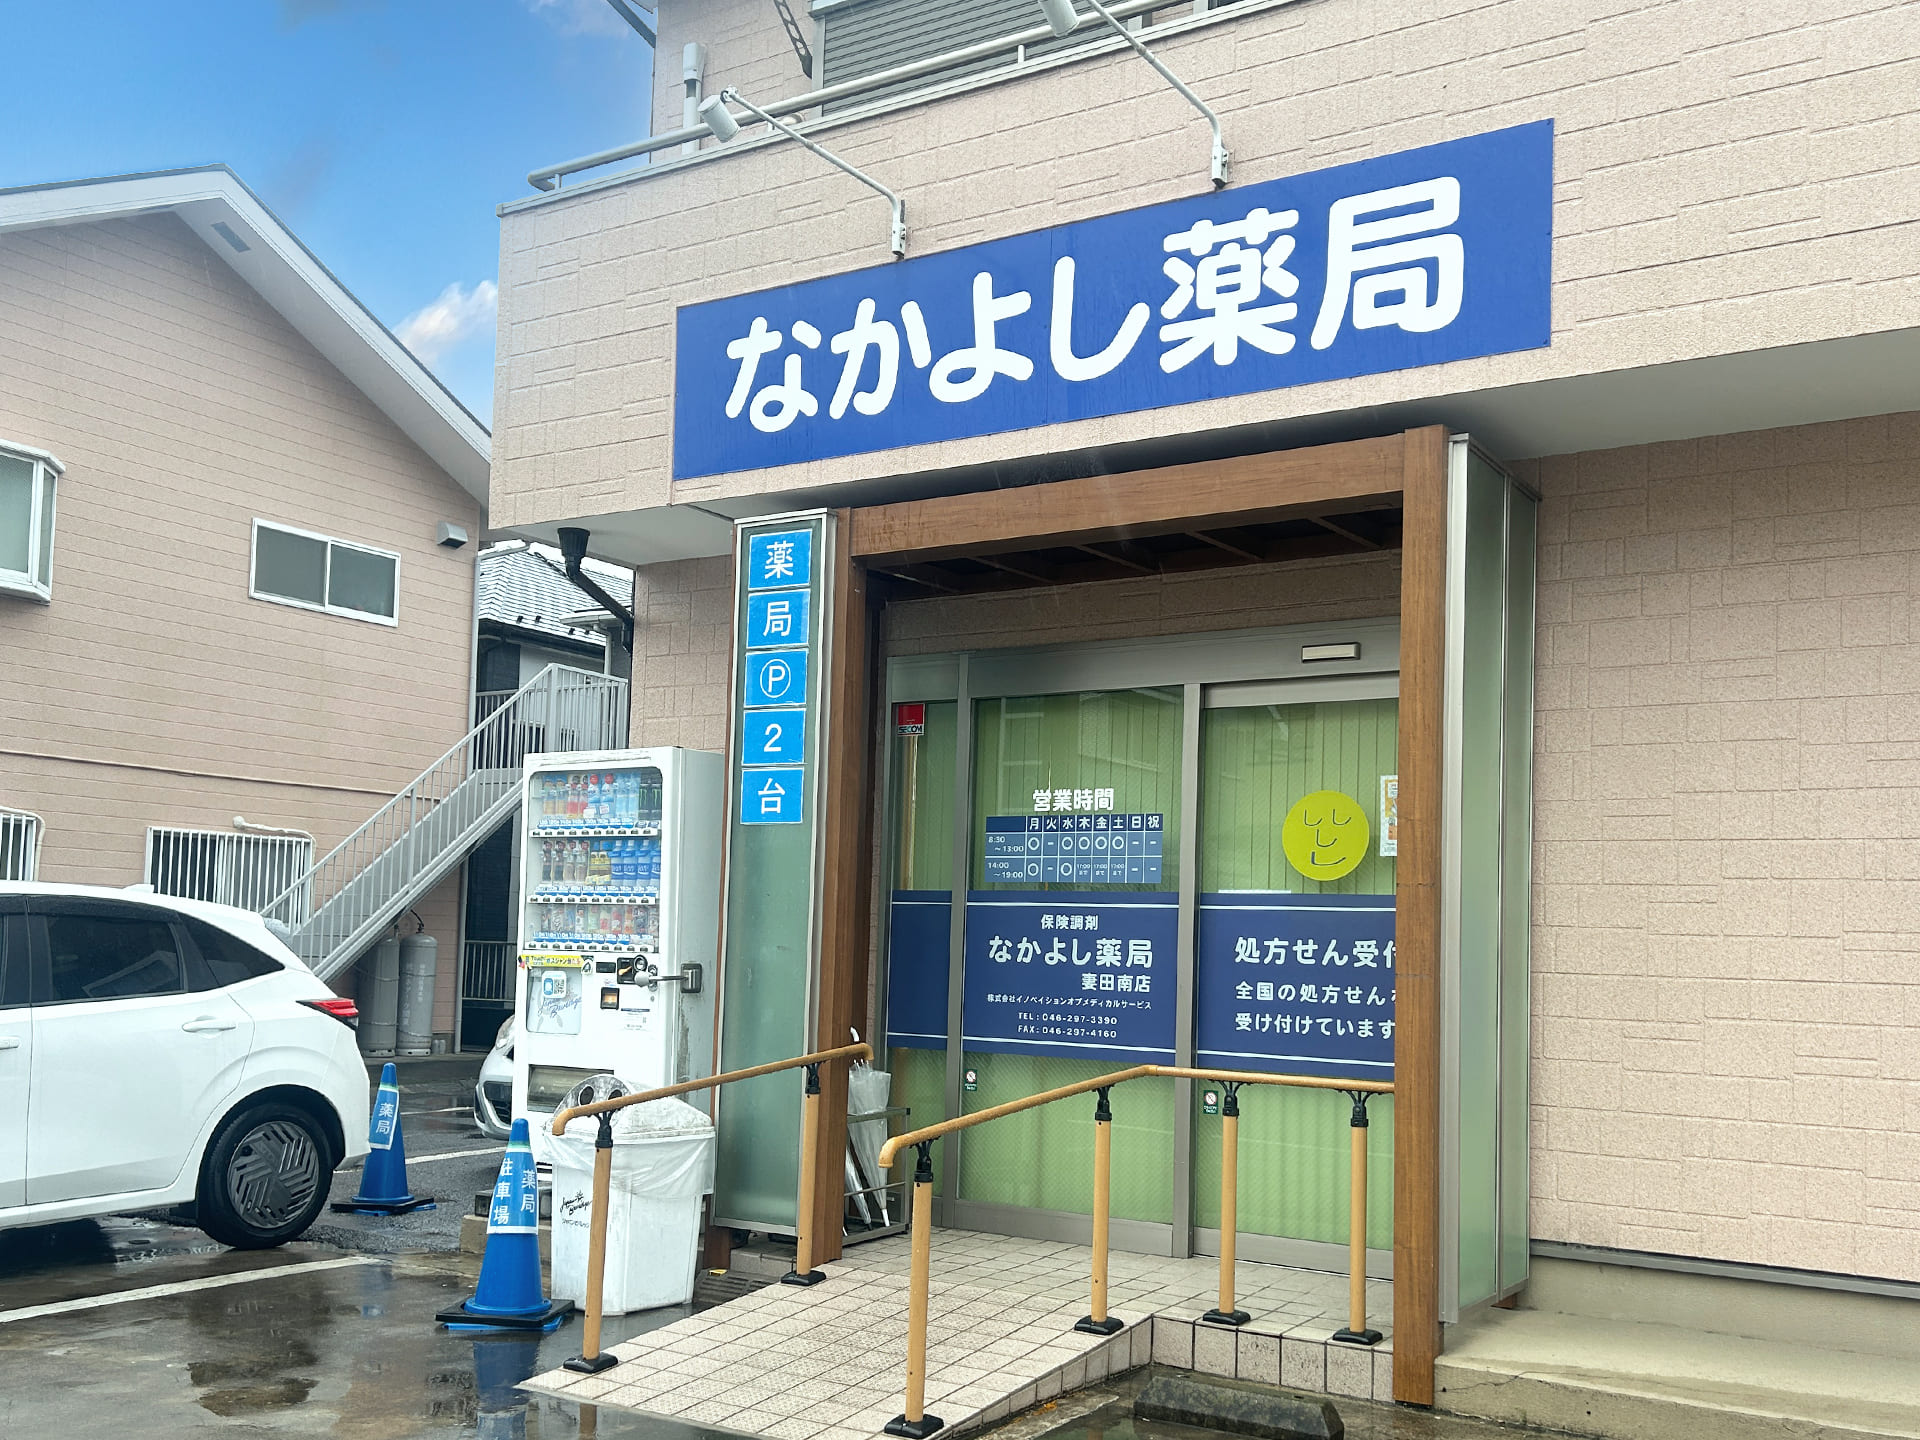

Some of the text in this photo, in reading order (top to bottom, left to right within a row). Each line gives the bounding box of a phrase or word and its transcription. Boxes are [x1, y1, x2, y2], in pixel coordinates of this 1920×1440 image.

[726, 177, 1465, 434] なかよし薬局
[1032, 788, 1115, 812] 営業時間
[1029, 815, 1160, 830] 月 火 水 木 金 土 日 祝
[988, 861, 1010, 869] 14:00
[1040, 914, 1099, 931] 保険調剤
[988, 935, 1153, 969] なかよし薬局
[1081, 972, 1152, 993] 妻田南店
[1235, 980, 1396, 1006] 全国の処方せん
[1042, 1013, 1118, 1025] 046-297-3390
[1042, 1026, 1118, 1038] 046-297-4160
[376, 1102, 395, 1135] 薬局
[521, 1168, 536, 1213] 薬局
